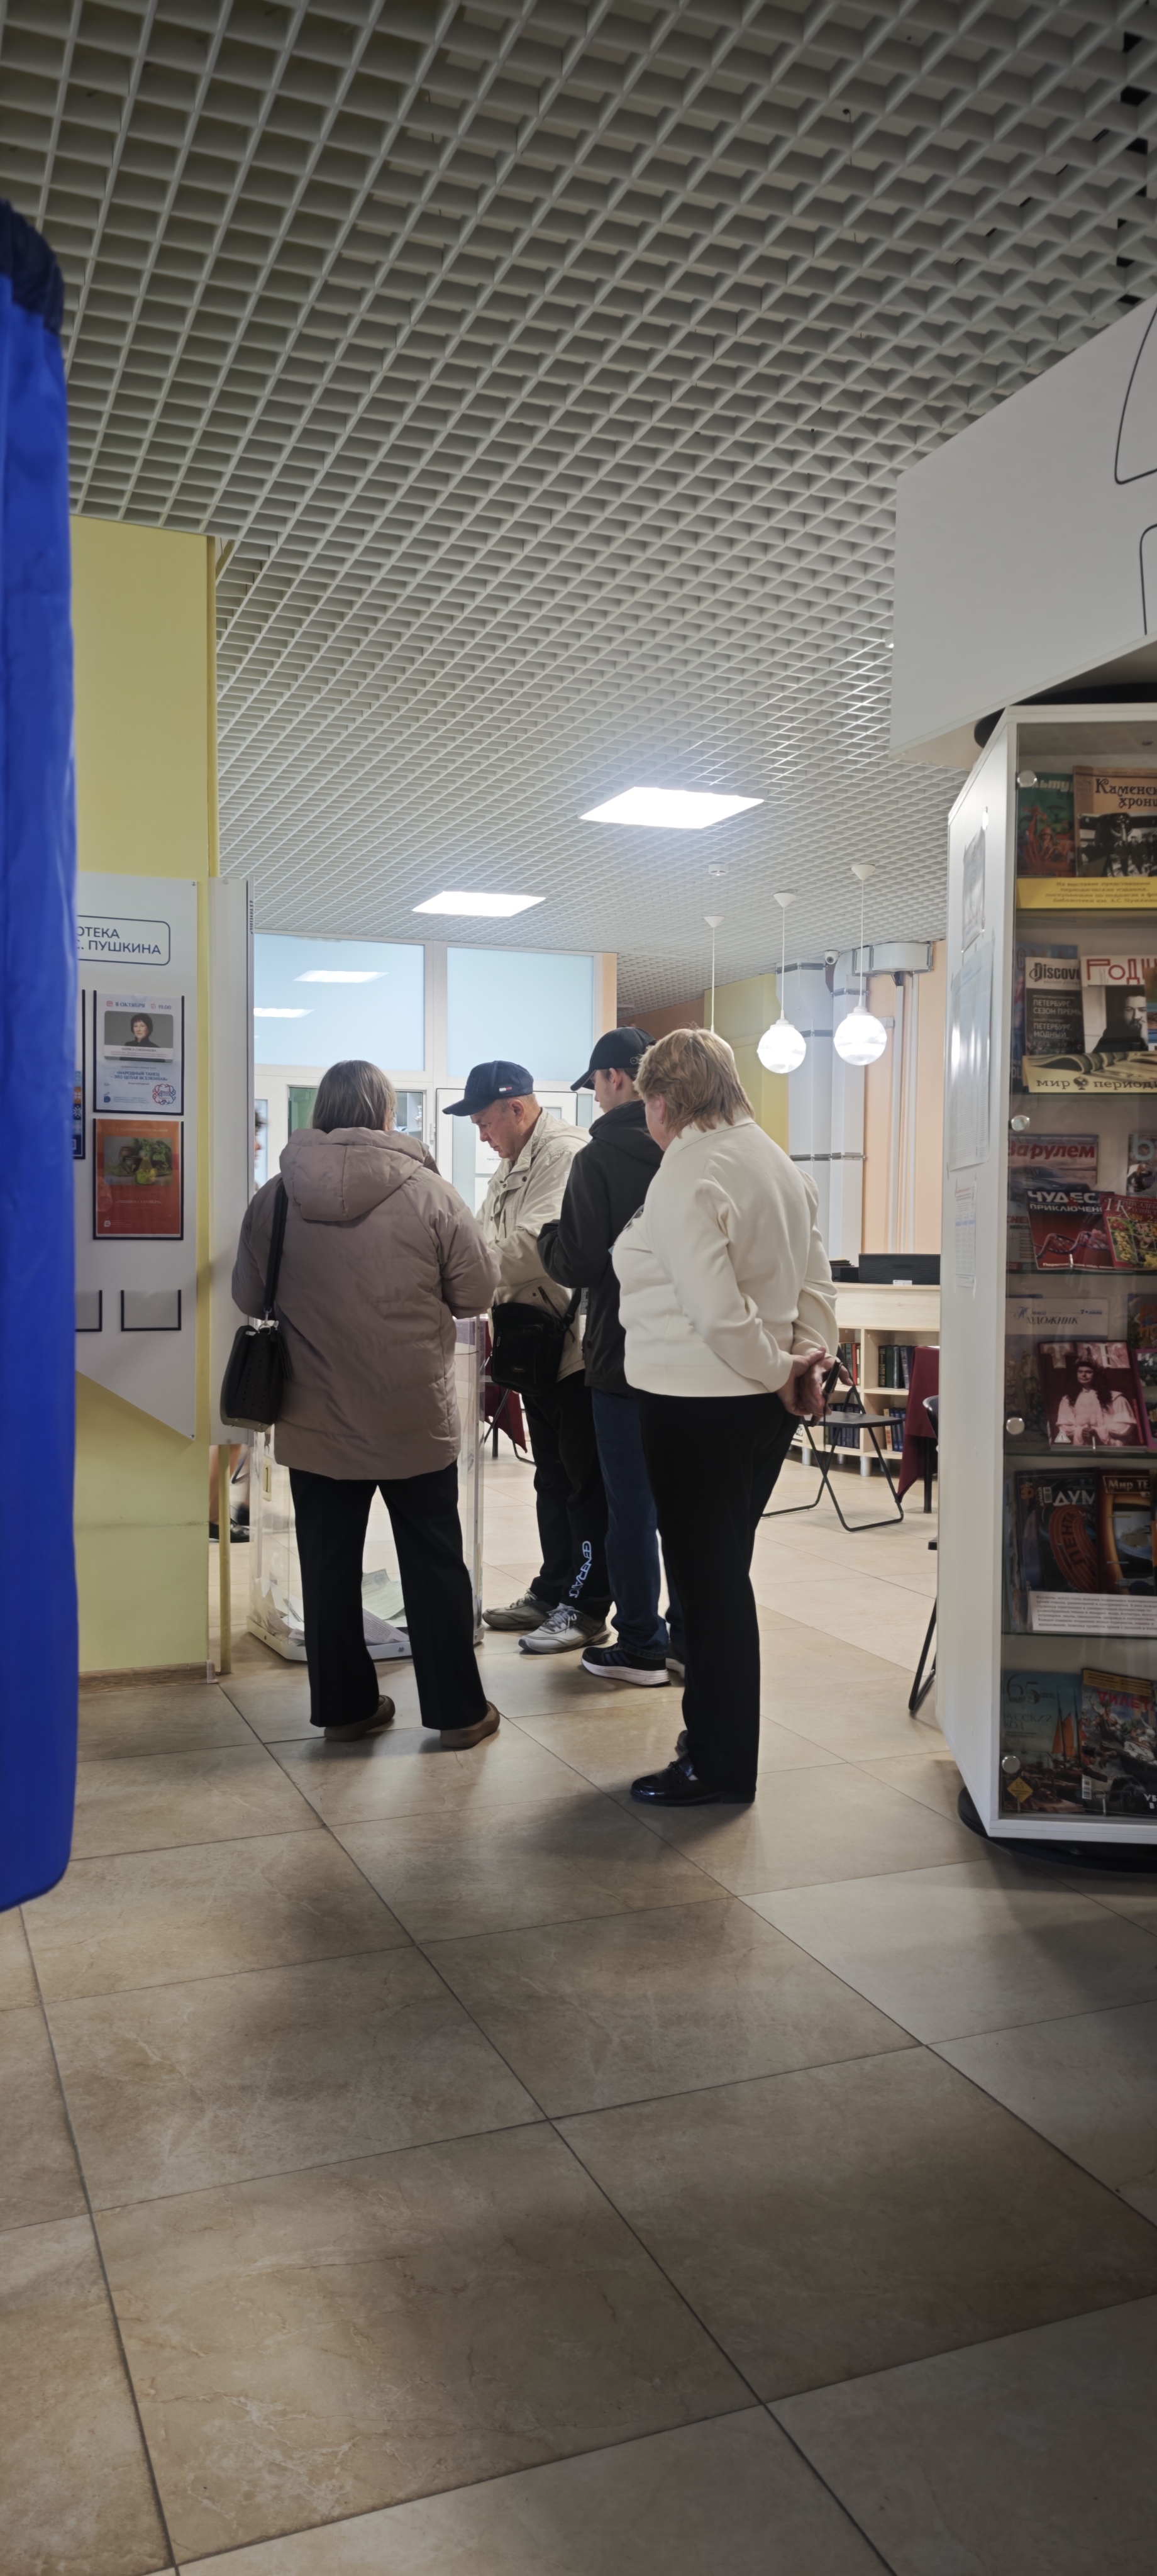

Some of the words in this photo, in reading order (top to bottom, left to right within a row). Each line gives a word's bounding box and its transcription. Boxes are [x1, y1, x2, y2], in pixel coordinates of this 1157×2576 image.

[89, 940, 162, 955] ПУШКИНА
[1036, 1079, 1071, 1090] мир
[1027, 1191, 1100, 1204] ЧУДЕС
[1108, 1479, 1134, 1491] Мир
